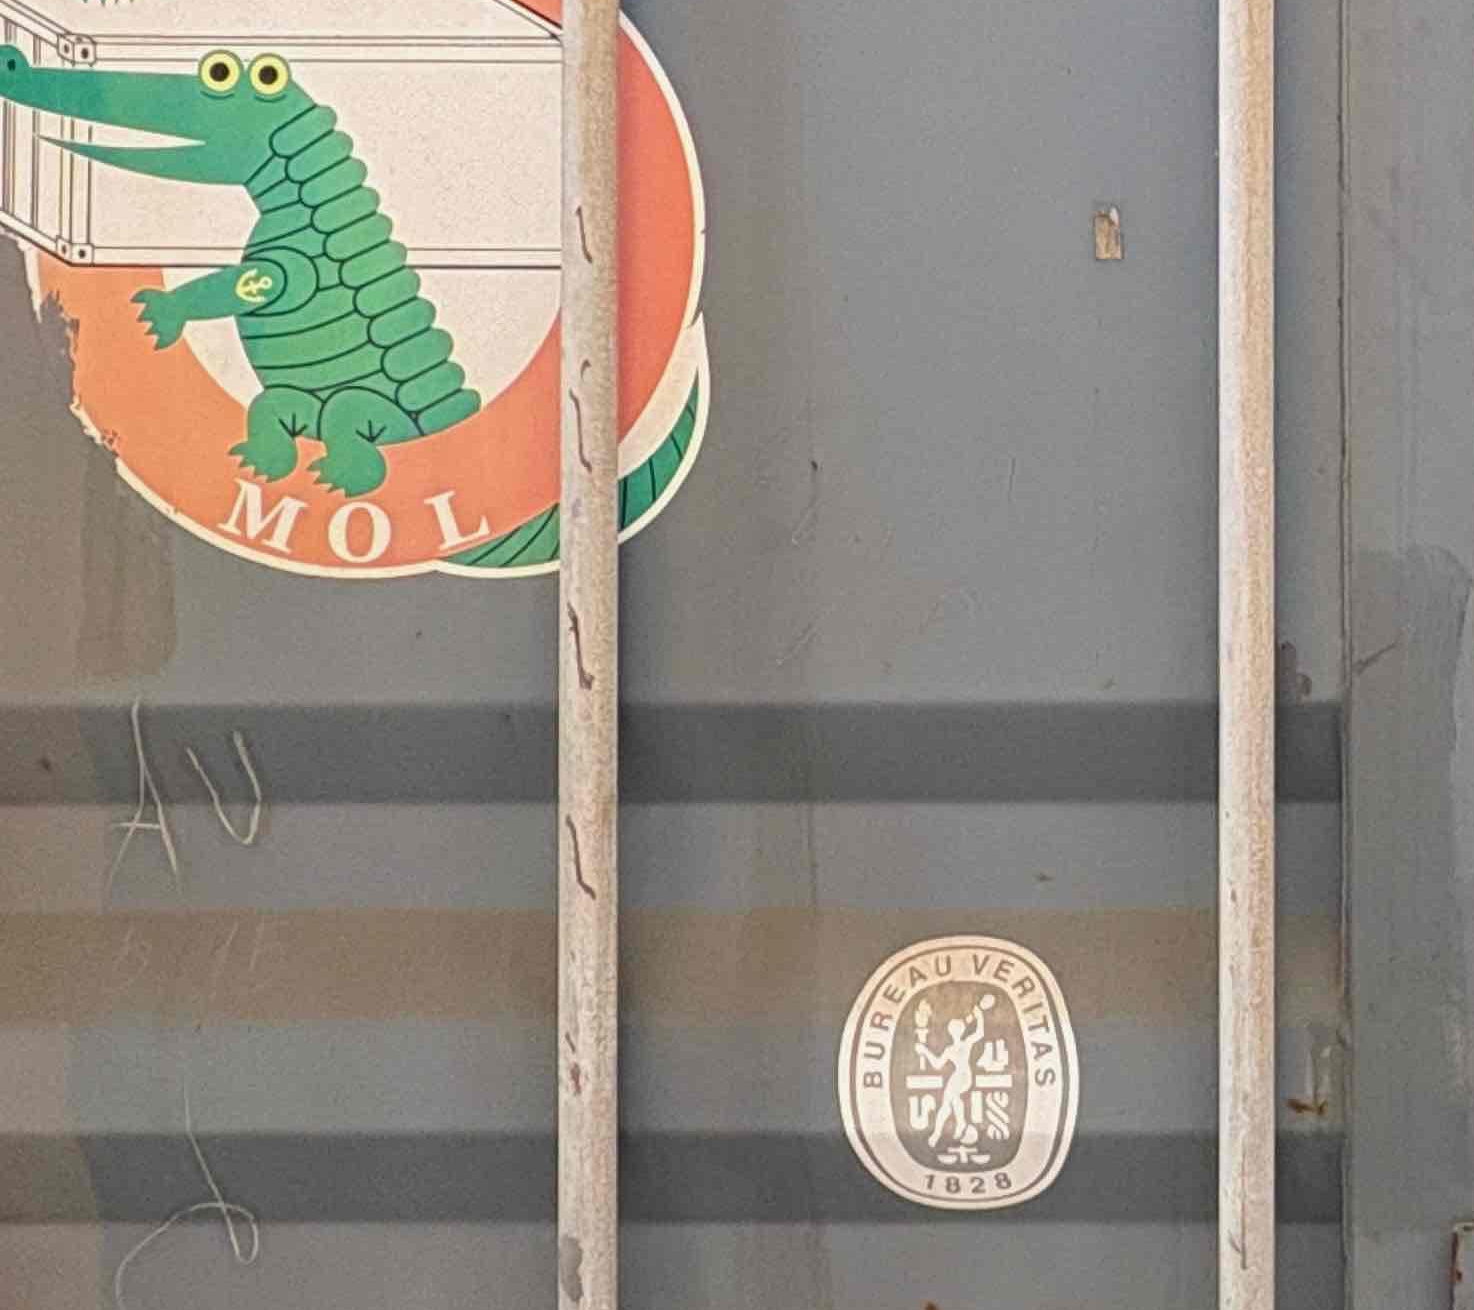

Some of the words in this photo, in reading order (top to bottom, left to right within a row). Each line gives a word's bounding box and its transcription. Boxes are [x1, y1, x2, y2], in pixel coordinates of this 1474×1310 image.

[218, 478, 490, 562] MOL
[863, 955, 951, 1089] BUREAU
[972, 954, 1056, 1088] VERITAS
[924, 1172, 1012, 1194] 1828
